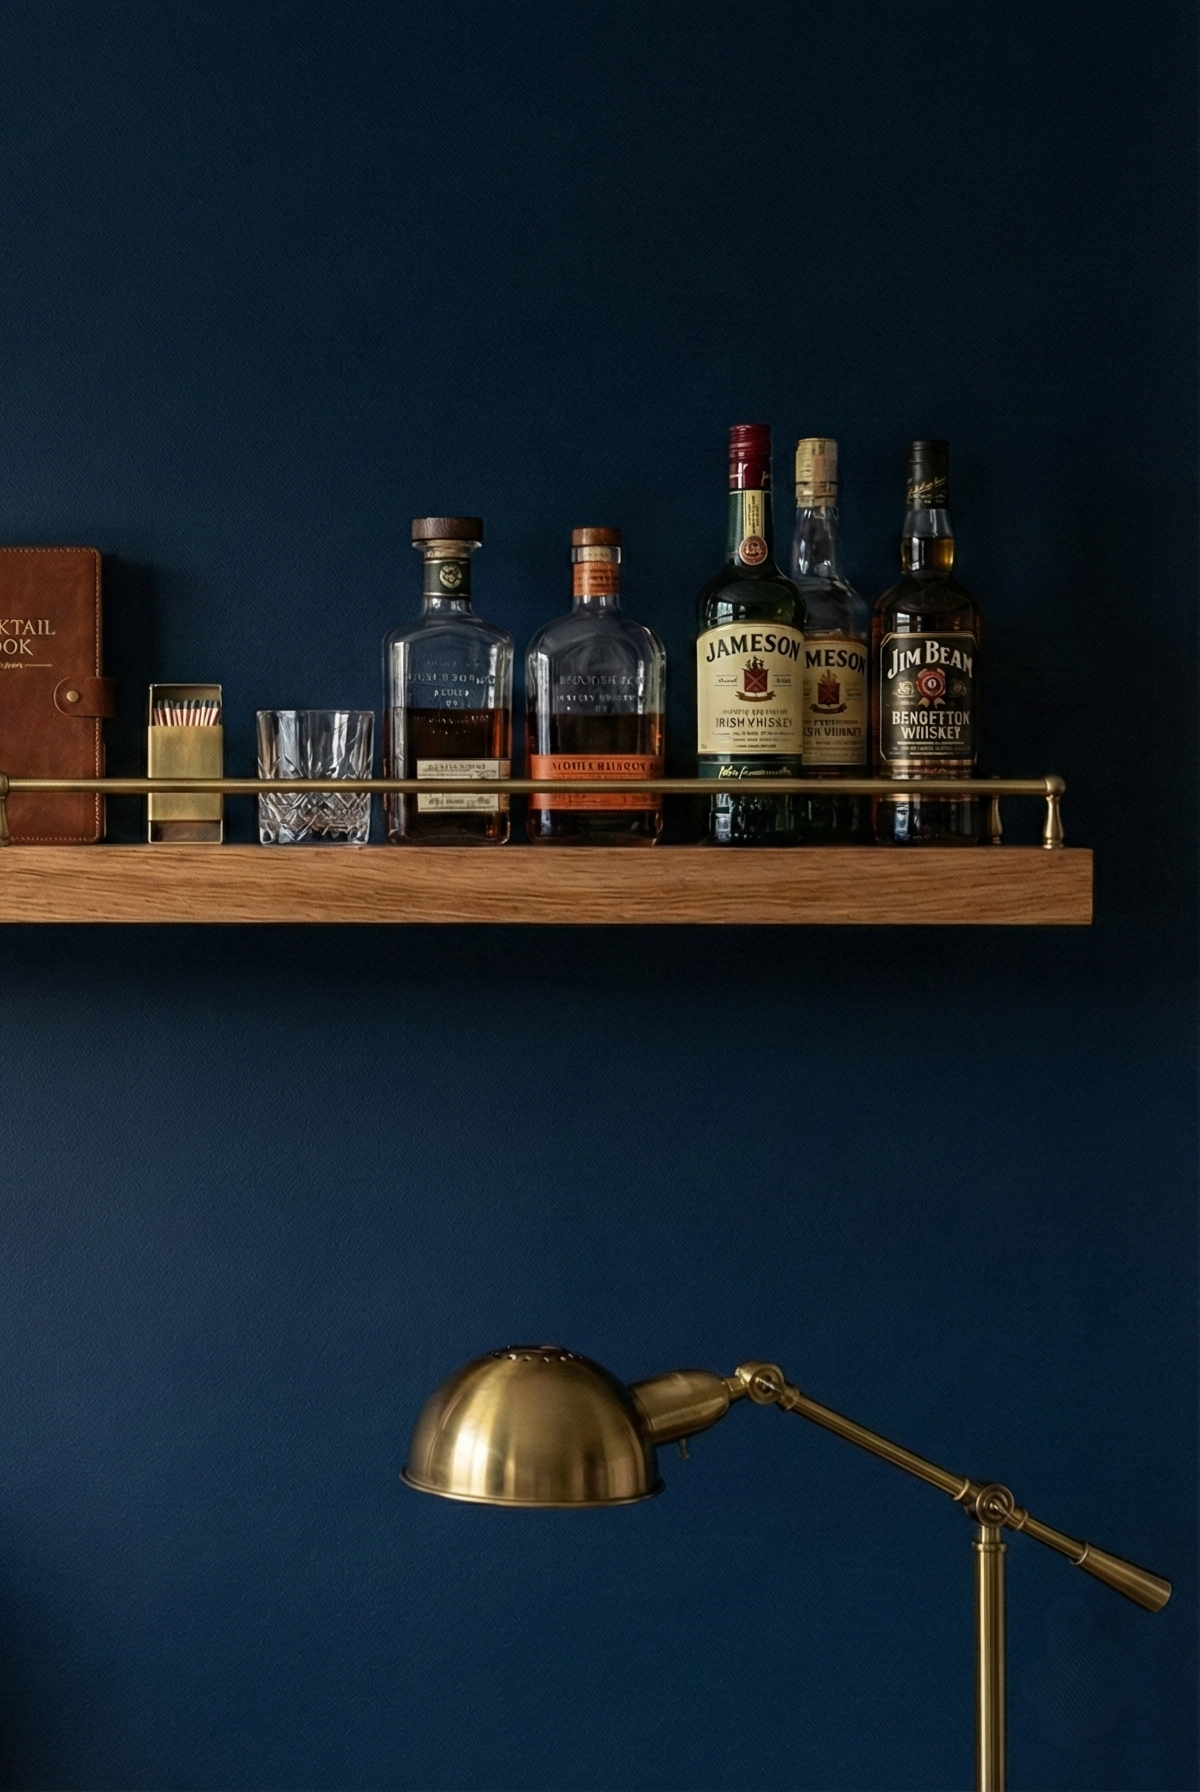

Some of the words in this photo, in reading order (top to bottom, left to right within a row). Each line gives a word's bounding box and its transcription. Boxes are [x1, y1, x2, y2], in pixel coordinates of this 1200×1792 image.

[706, 633, 801, 663] JAMESON
[805, 649, 867, 676] MESON
[887, 648, 922, 679] JIM
